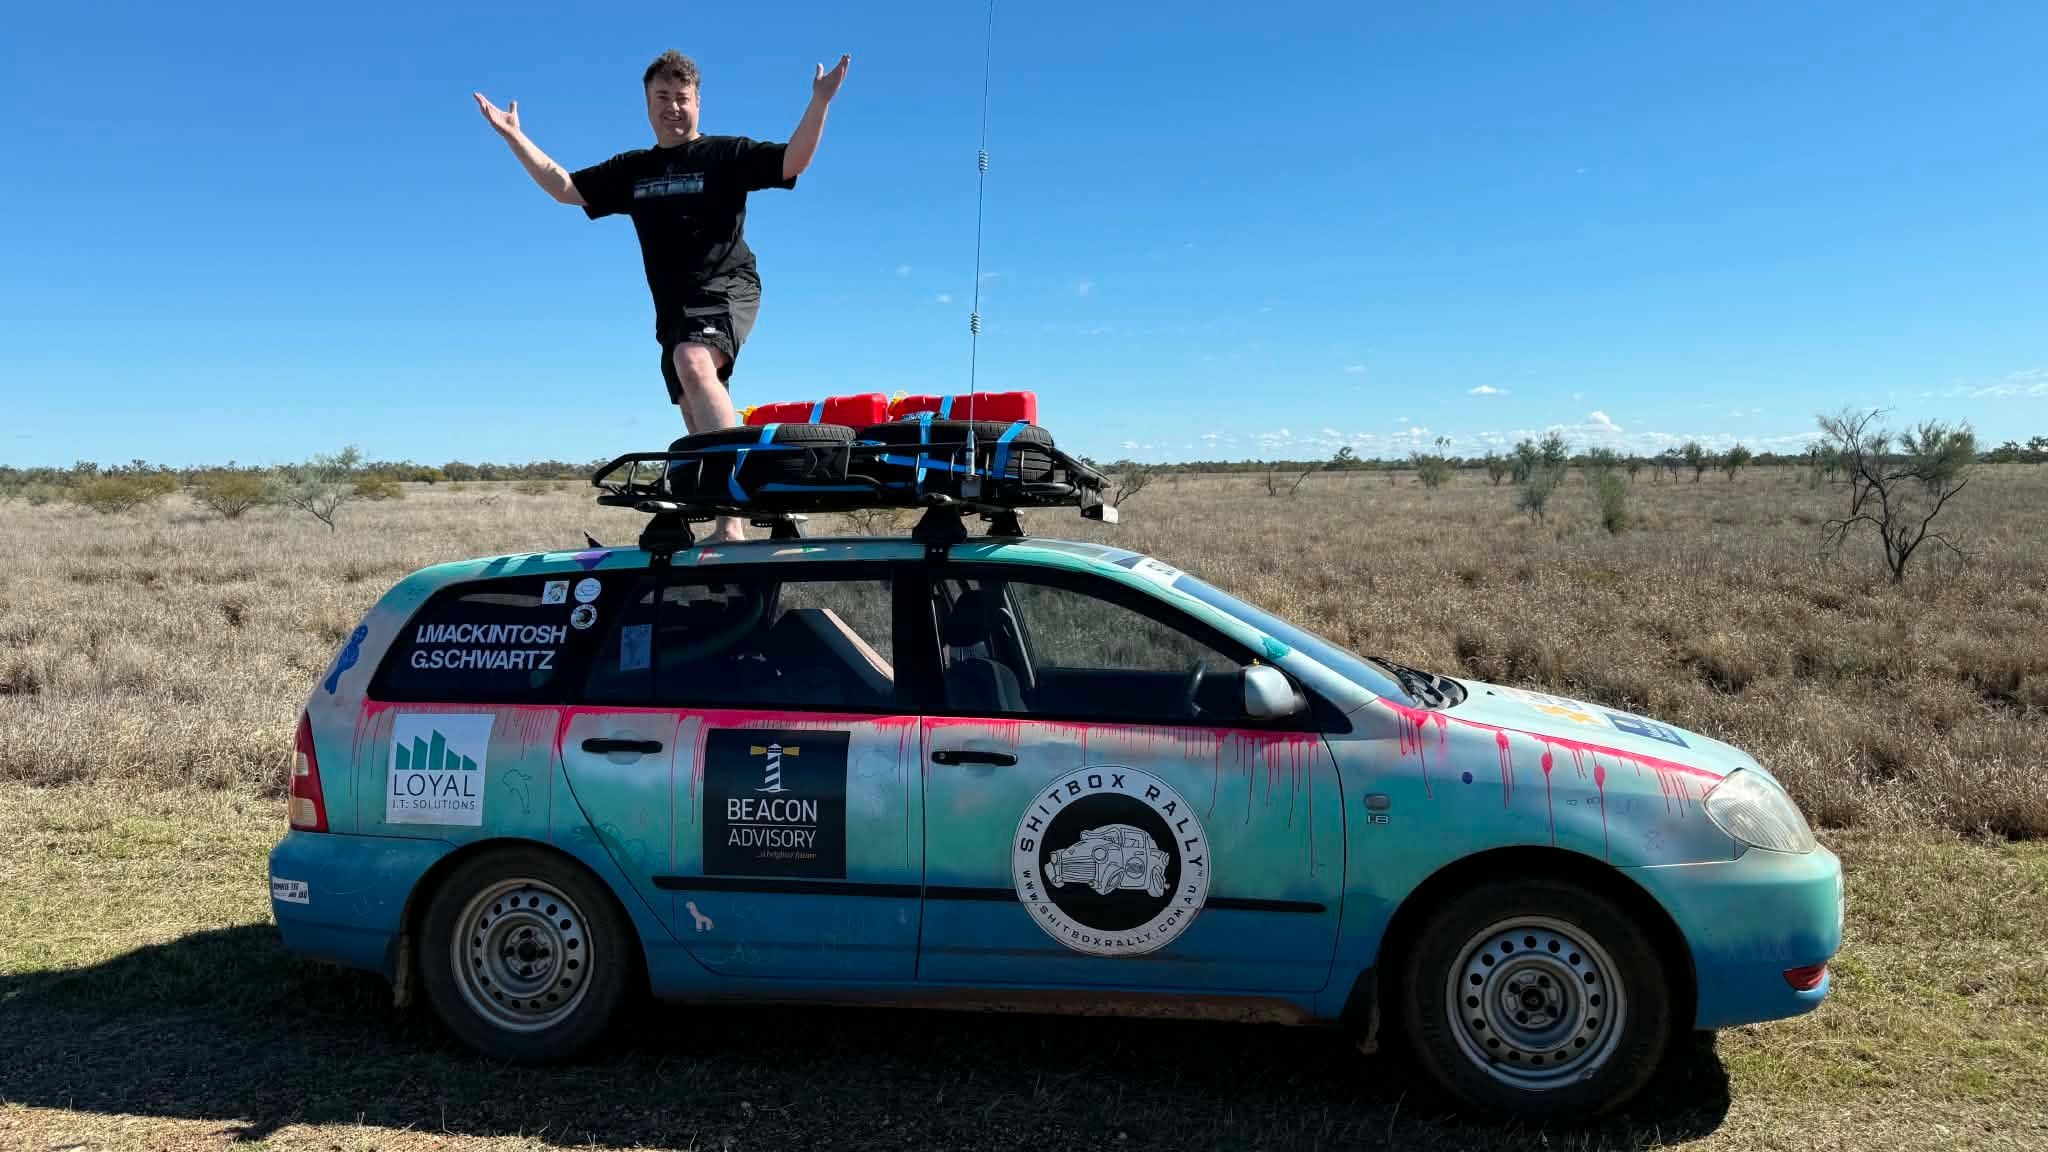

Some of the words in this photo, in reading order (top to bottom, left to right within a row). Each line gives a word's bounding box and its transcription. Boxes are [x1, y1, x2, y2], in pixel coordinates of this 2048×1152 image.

[411, 650, 555, 670] G.SCHWARTZ
[394, 774, 476, 797] LOYAL
[413, 799, 475, 810] SOLUTIONS
[727, 798, 818, 822] BEACON
[1020, 773, 1126, 853] SHITBOX
[1144, 784, 1204, 868] RALLY
[728, 828, 817, 848] ADVISORY
